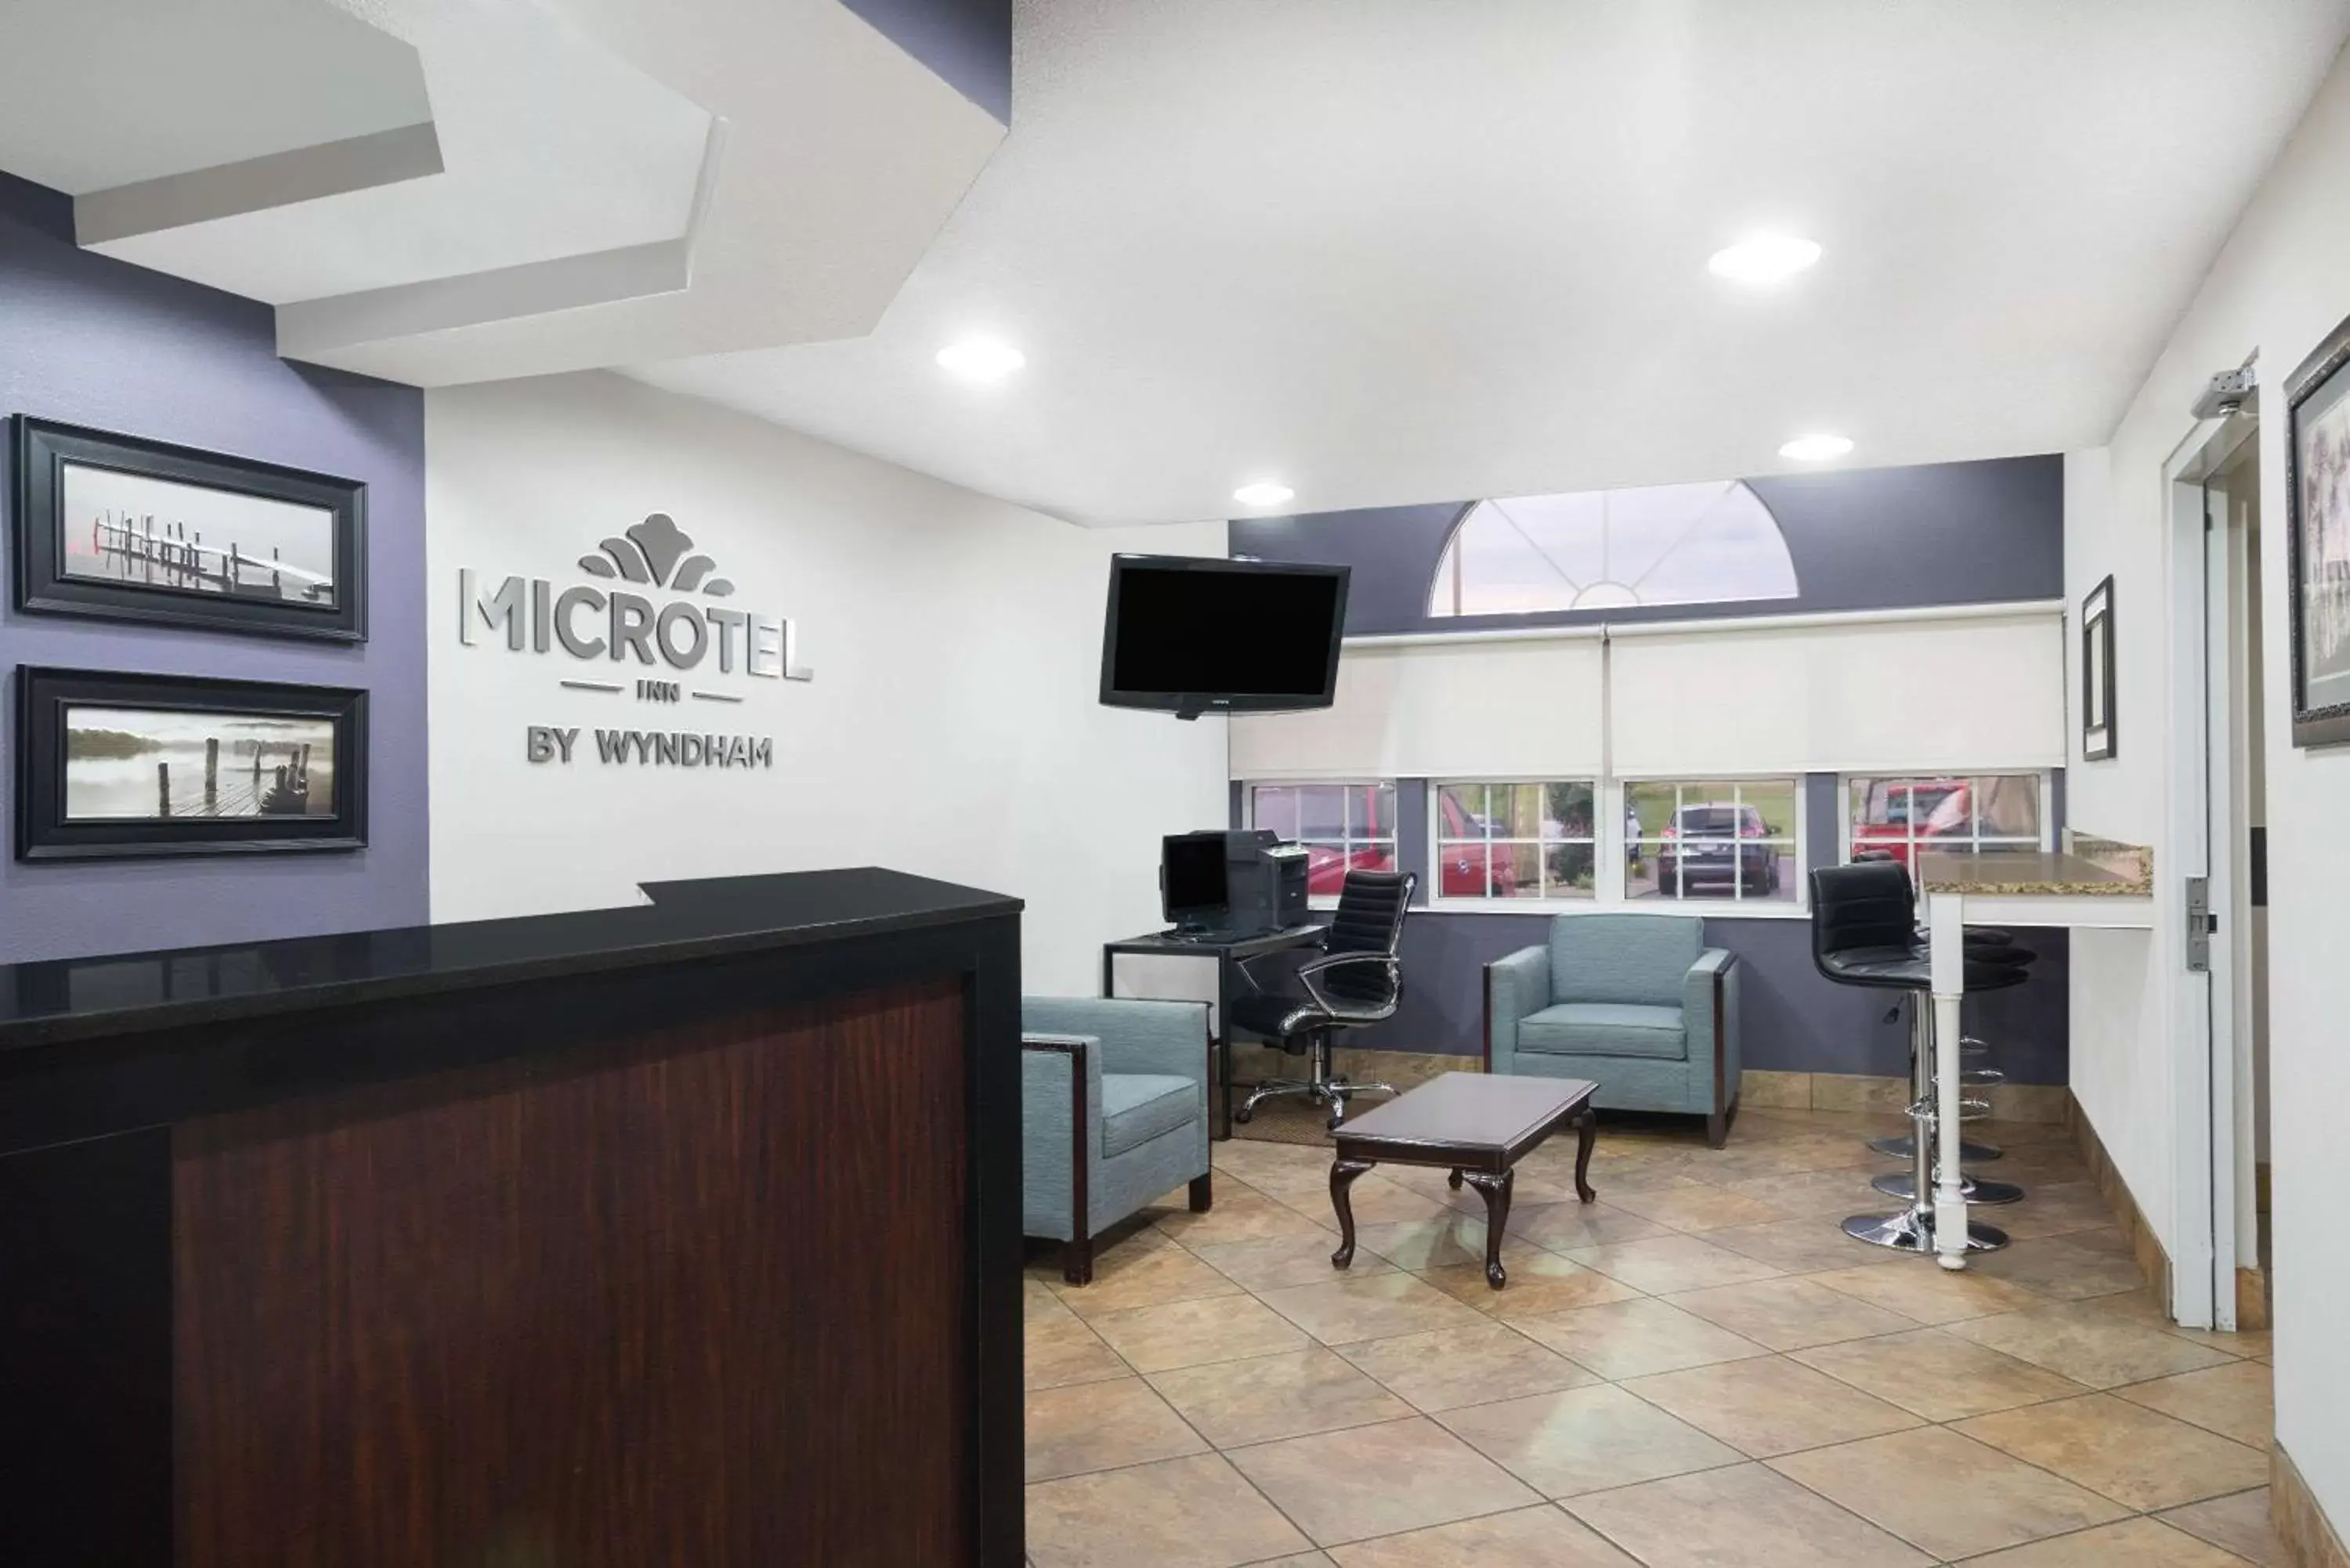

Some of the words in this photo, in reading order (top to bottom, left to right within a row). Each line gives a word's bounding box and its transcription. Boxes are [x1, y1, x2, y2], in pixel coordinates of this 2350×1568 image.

[457, 568, 813, 681] MICROTEL
[636, 679, 680, 703] INN
[527, 725, 580, 764] BY
[595, 728, 773, 768] WYNDHAM
